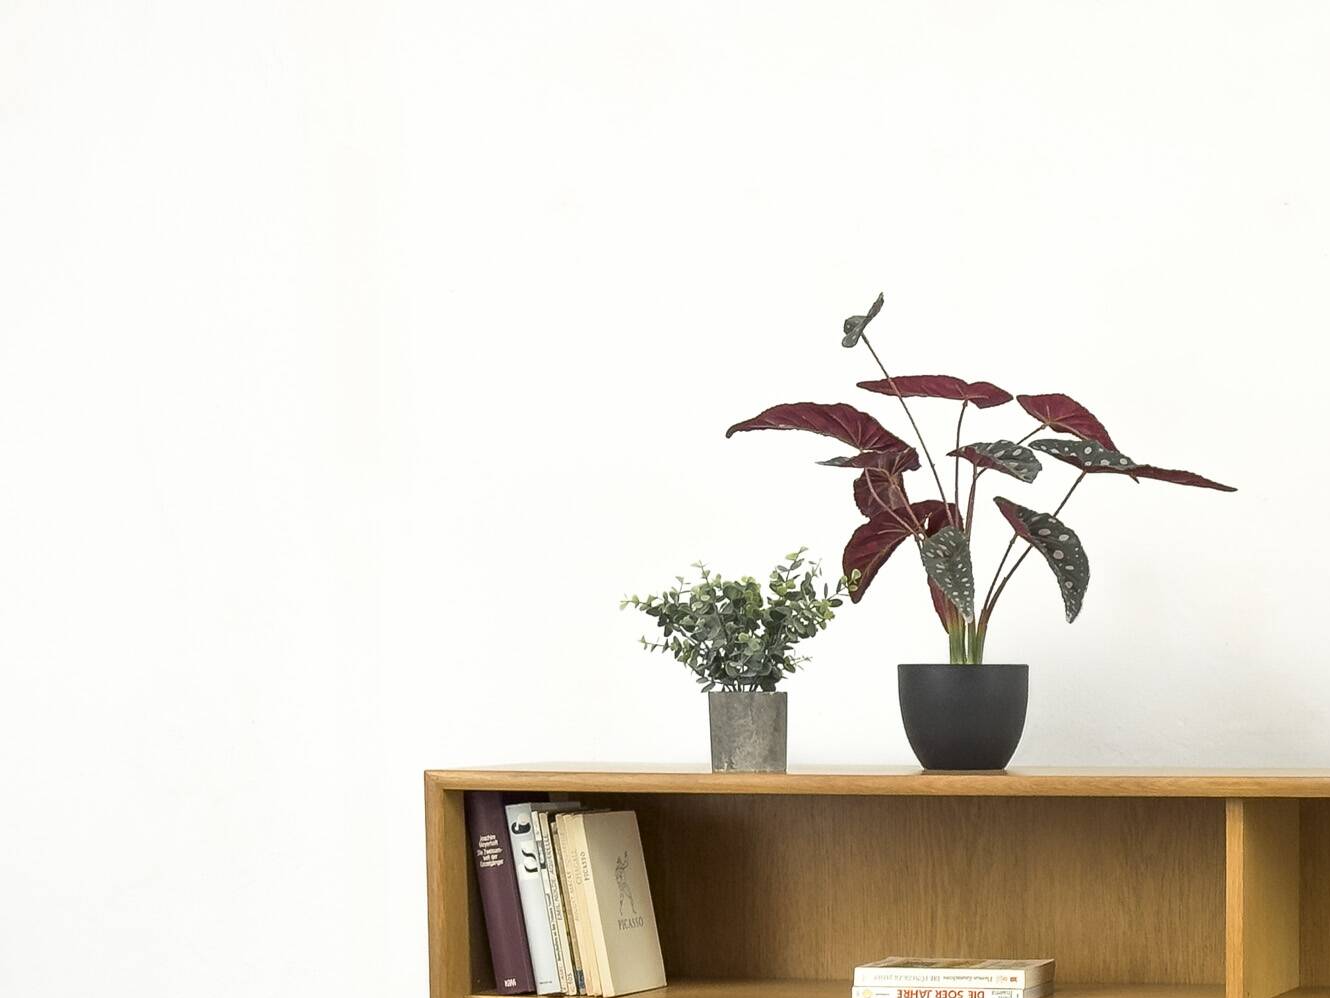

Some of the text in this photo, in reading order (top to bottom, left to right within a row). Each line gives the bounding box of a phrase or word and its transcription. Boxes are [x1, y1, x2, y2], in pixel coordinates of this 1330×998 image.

[580, 851, 590, 881] PICASSO
[618, 917, 644, 931] PICASSO
[897, 989, 933, 998] JAHRE
